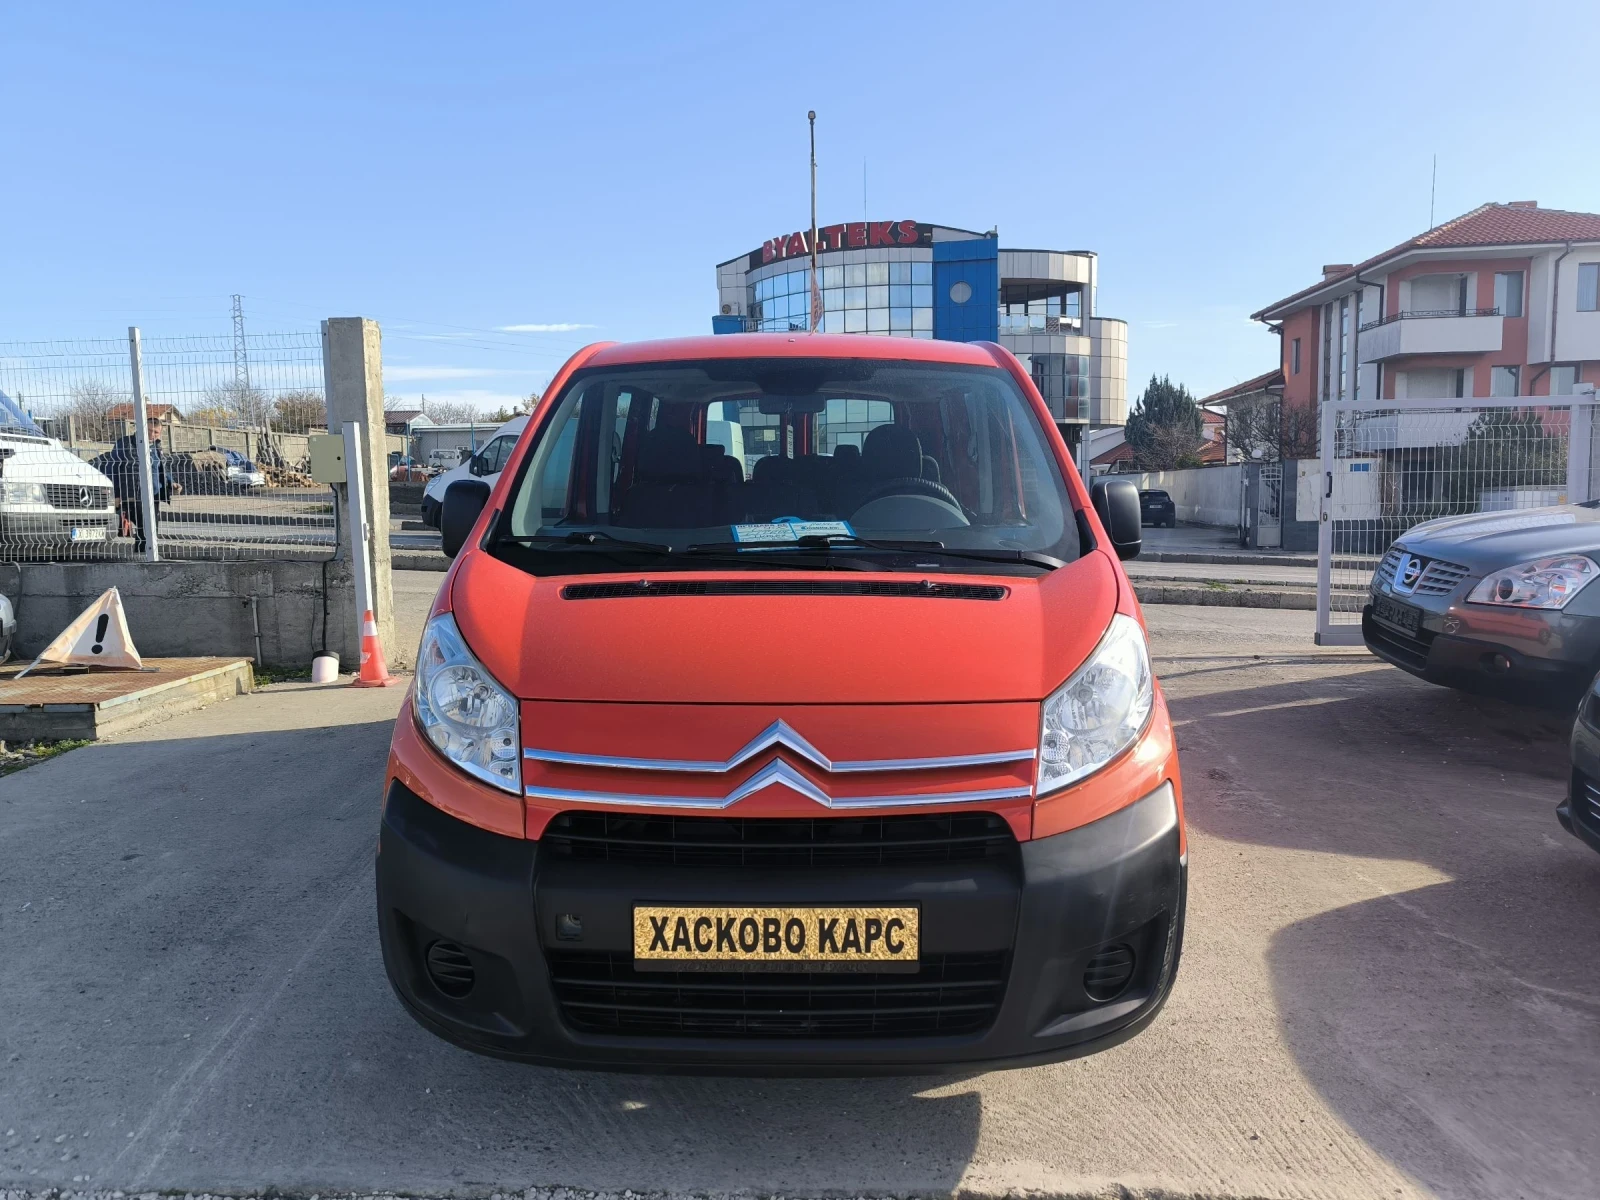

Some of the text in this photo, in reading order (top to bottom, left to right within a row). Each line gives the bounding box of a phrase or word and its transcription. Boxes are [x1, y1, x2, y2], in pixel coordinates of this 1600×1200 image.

[762, 220, 919, 263] BYALTEKS
[649, 916, 905, 954] ХАСКОВО КАРС
